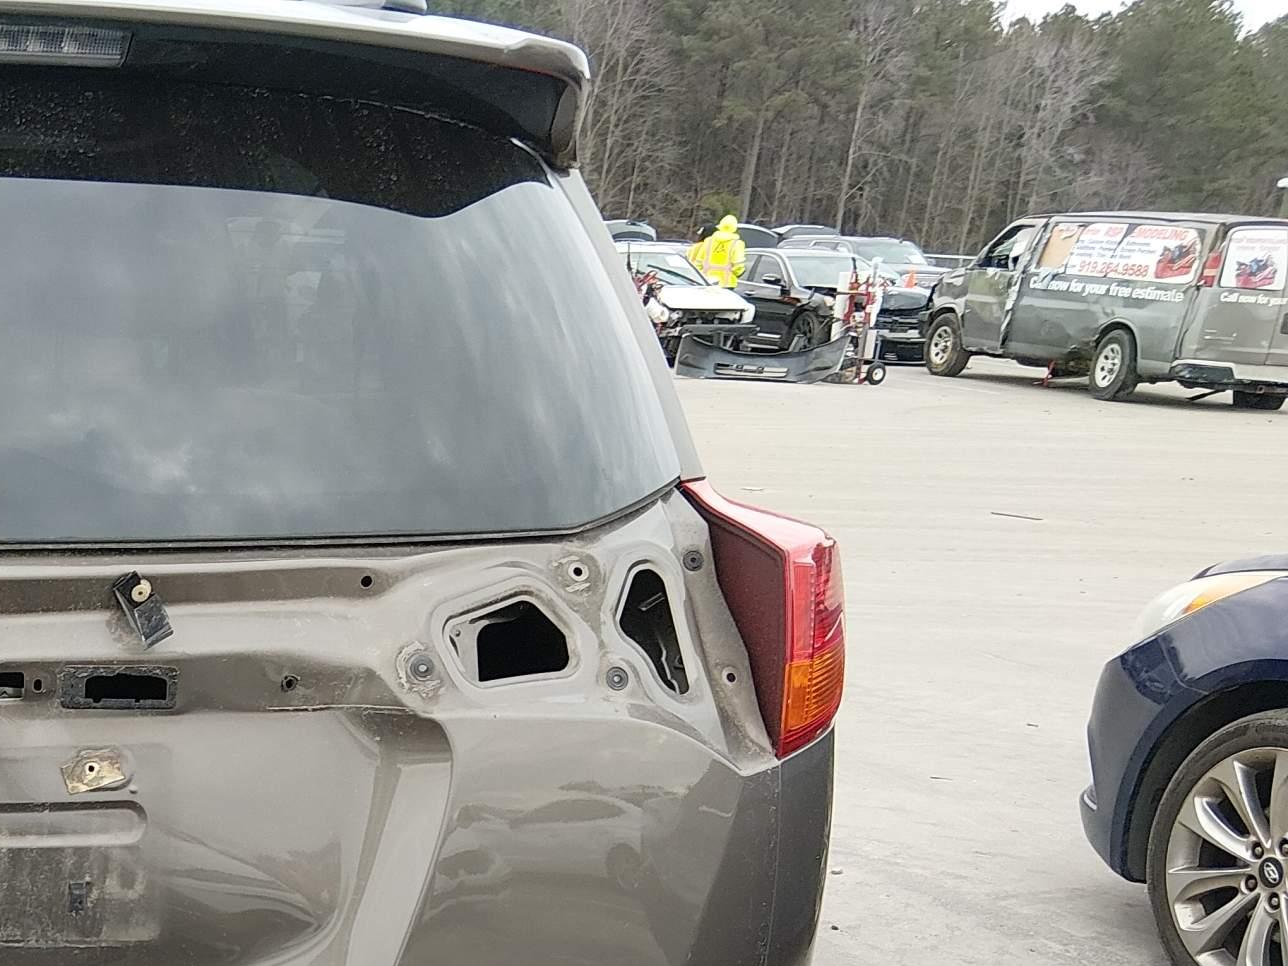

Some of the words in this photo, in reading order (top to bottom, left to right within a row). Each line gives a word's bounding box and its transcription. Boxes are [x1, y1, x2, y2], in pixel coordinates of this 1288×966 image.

[1068, 279, 1084, 292] for
[1082, 282, 1109, 296] your
[1109, 283, 1132, 297] free
[1132, 286, 1185, 302] estimate
